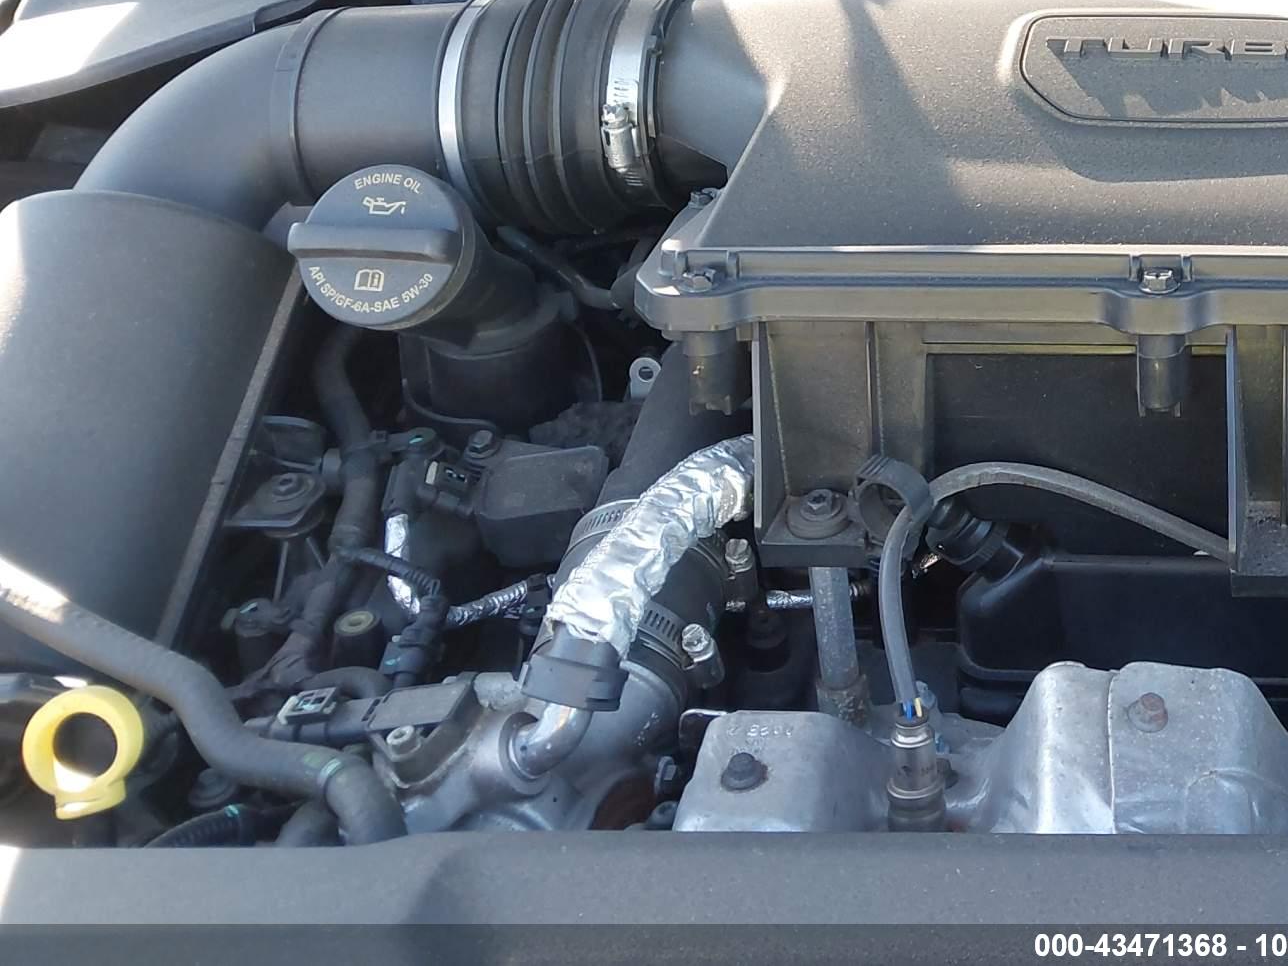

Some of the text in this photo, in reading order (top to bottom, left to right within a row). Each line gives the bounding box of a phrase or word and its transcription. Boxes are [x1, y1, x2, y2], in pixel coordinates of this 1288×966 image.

[354, 173, 424, 194] ENGINE OIL
[308, 265, 325, 287] API
[401, 273, 433, 304] 5W-30
